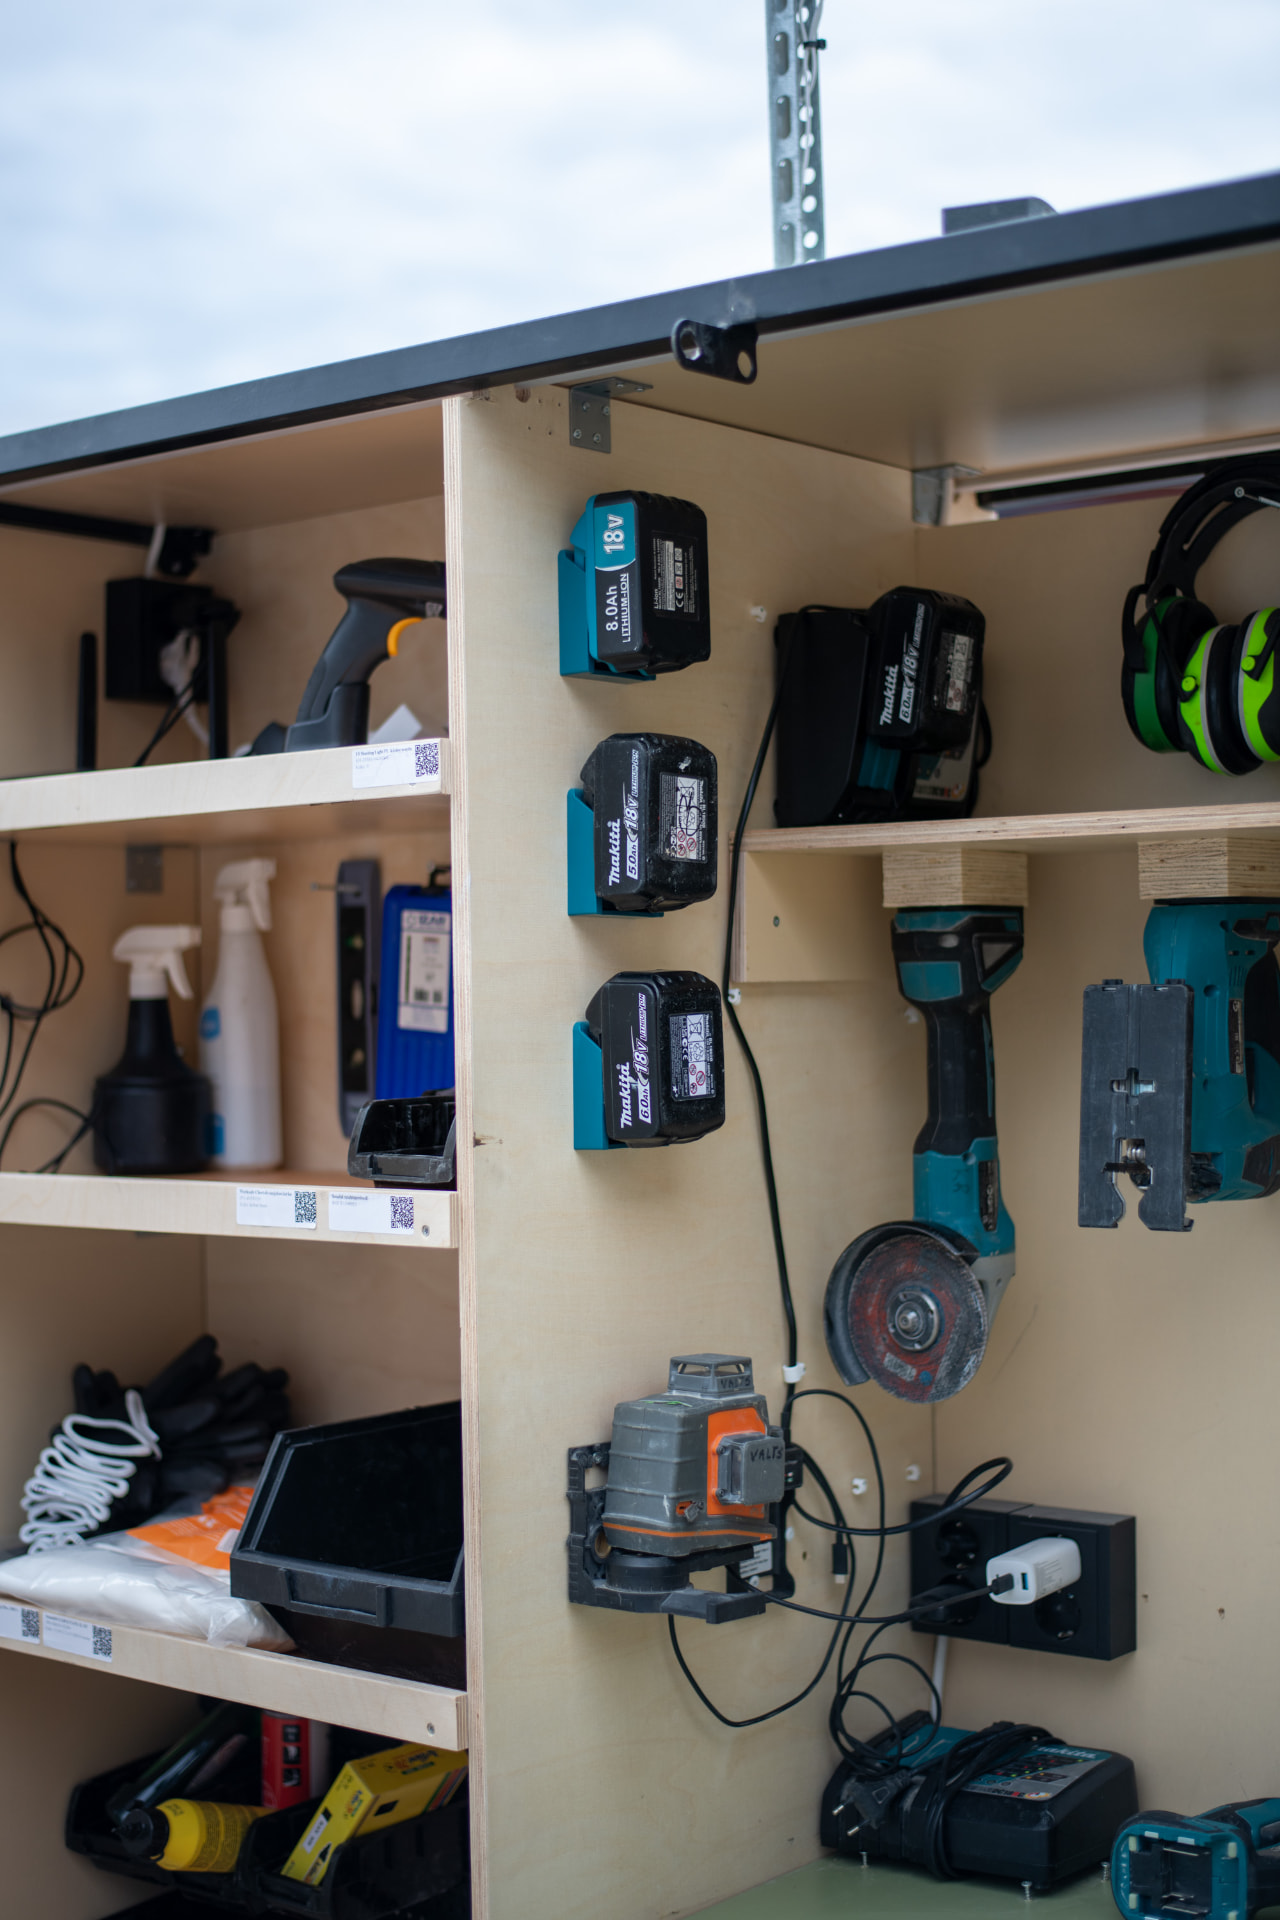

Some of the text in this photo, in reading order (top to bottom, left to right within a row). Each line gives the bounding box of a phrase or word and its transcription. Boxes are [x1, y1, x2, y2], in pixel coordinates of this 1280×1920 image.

[603, 513, 625, 554] 18V
[606, 585, 618, 631] 8.0Ah
[621, 573, 631, 643] LITHIUM-ION
[902, 644, 920, 679] 18V
[879, 665, 899, 727] makita
[901, 690, 914, 721] 6.0Ah
[624, 794, 639, 831] 18V
[606, 818, 621, 886] makita
[627, 843, 638, 877] 5.0Ah
[632, 1037, 649, 1075] 18V
[616, 1062, 632, 1129] makita
[639, 1087, 650, 1120] 6.0Ah
[720, 1375, 751, 1389] VALTS
[750, 1446, 784, 1462] VALTS
